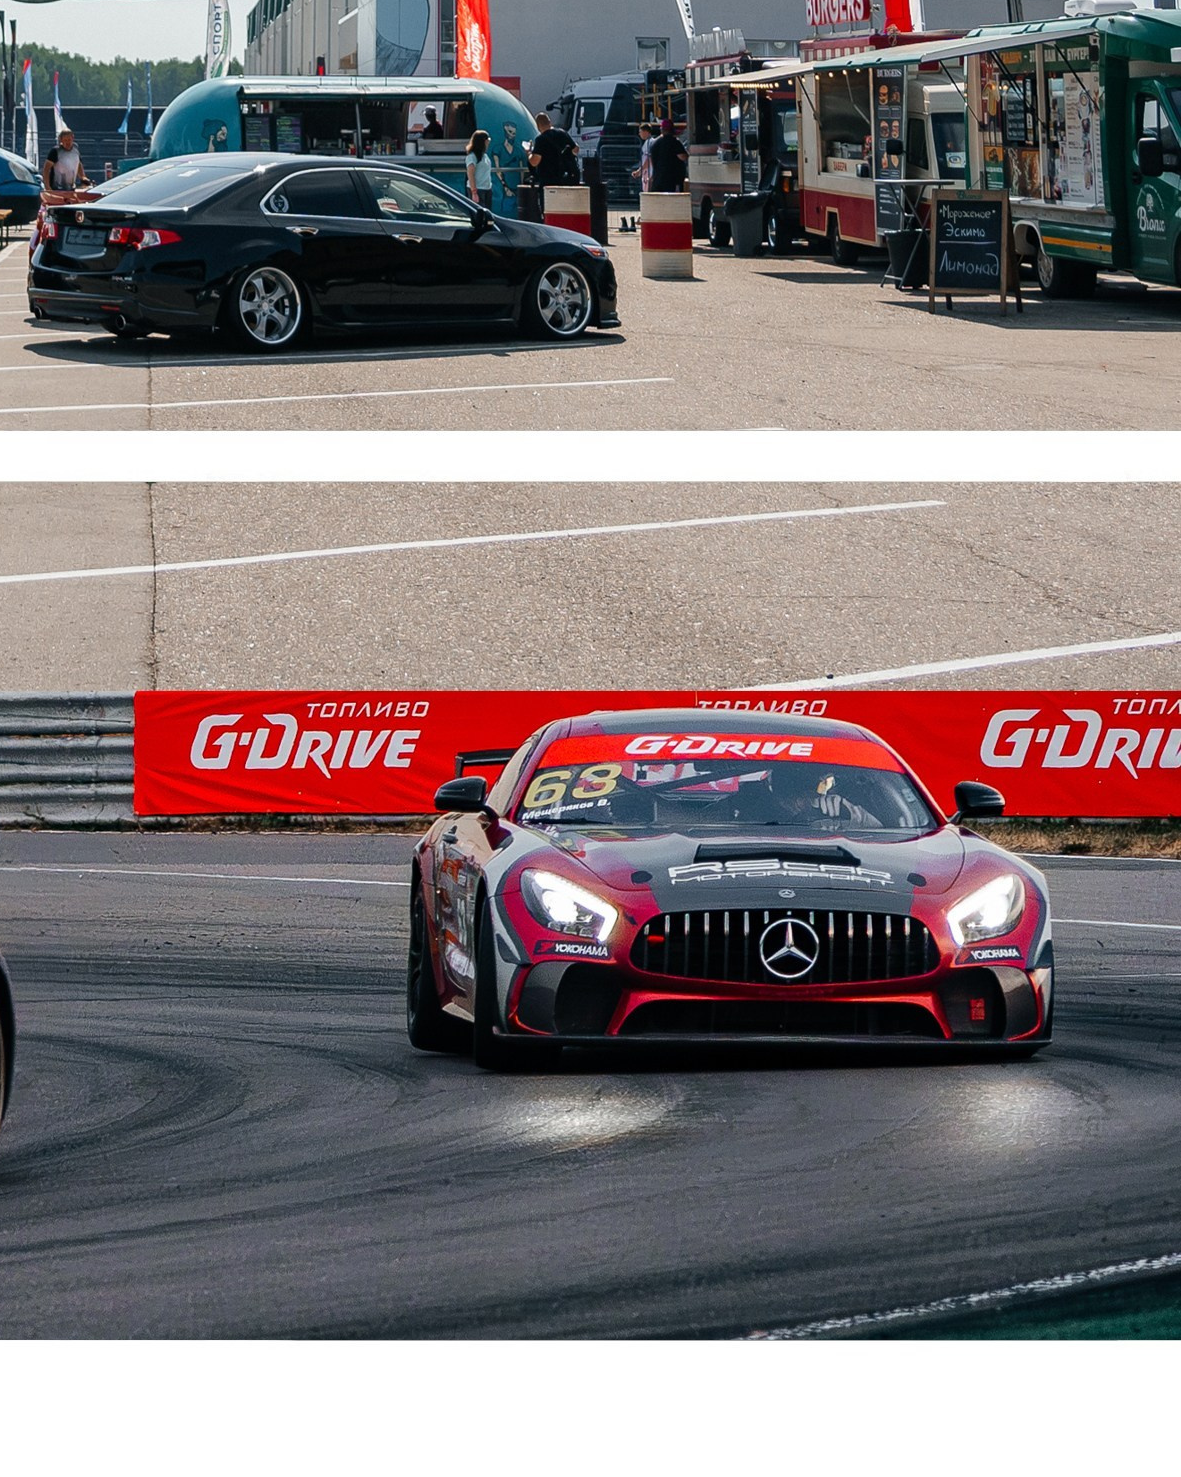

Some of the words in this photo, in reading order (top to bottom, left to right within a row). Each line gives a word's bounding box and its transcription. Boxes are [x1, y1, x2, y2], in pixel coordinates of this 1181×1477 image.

[877, 68, 902, 78] BURGERS
[942, 222, 985, 237] Эскимо
[939, 250, 999, 276] Лимонад
[307, 701, 430, 718] ТОПЛИВО
[1112, 699, 1181, 715] ТОПЛ
[555, 943, 608, 957] YOKOHAMA
[970, 948, 1020, 960] YOKOHAMA
